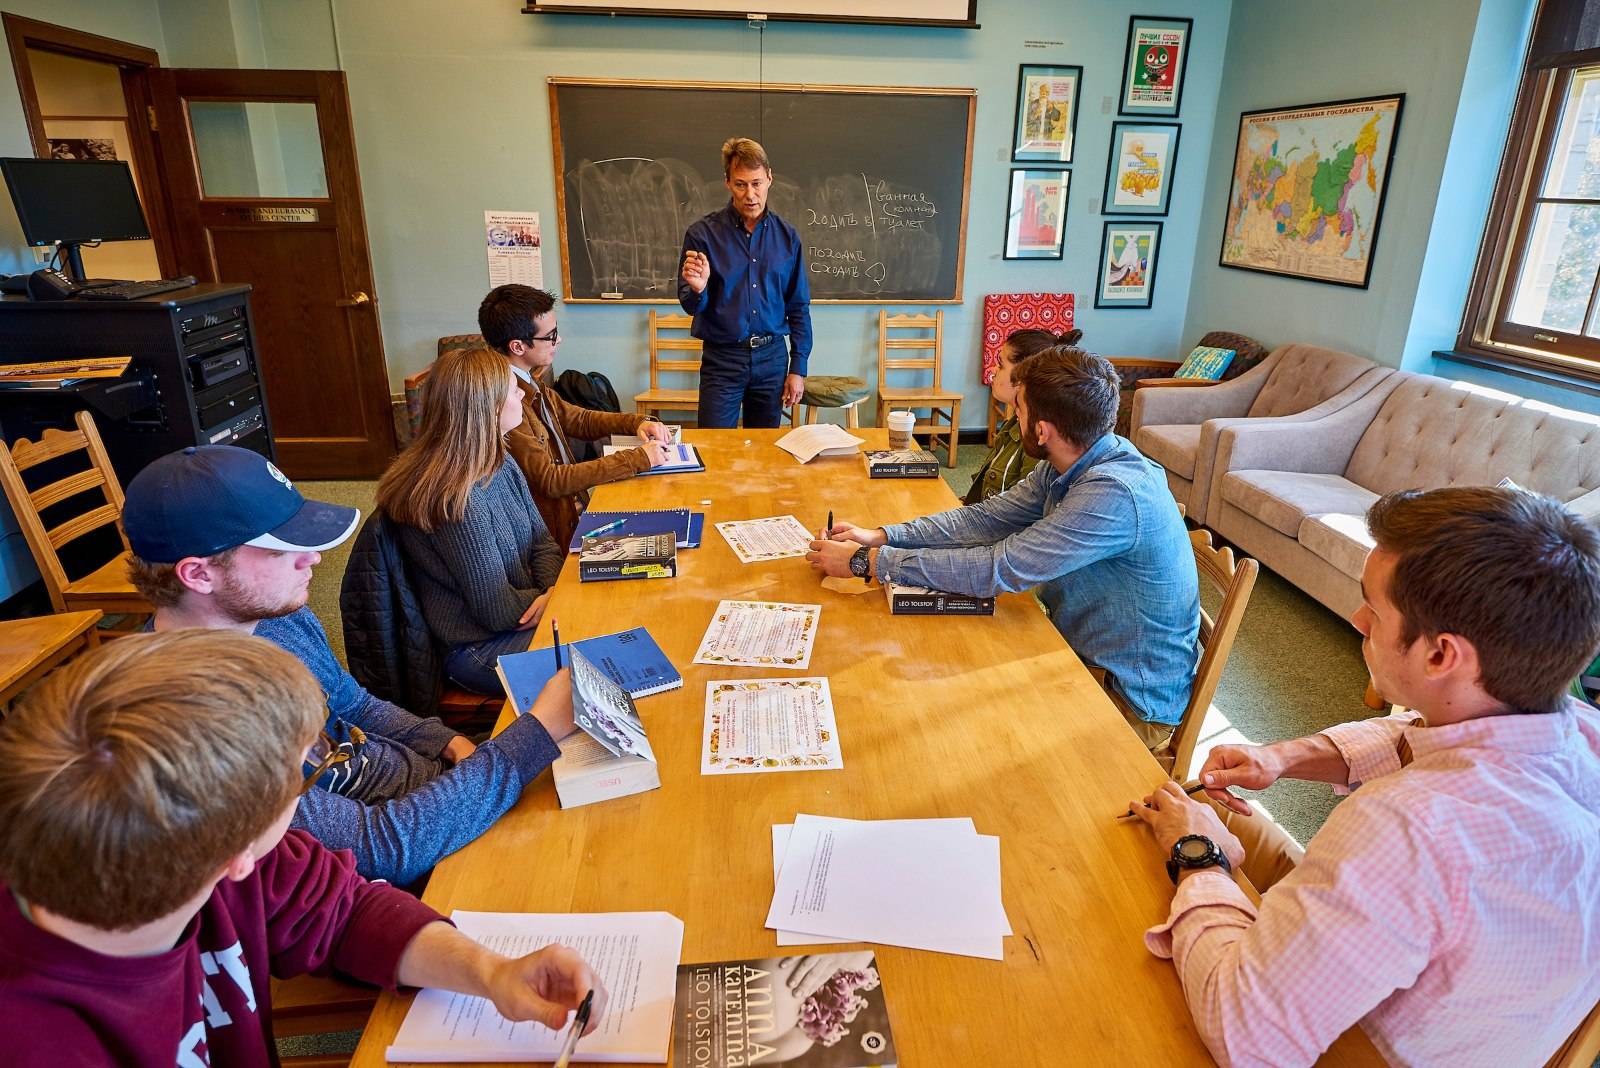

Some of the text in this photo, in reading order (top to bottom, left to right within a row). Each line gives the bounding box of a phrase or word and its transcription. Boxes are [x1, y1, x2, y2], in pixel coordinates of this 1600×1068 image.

[1326, 106, 1374, 116] ГОСУДАРСТВА
[695, 968, 711, 1068] LEO TOLSTOY
